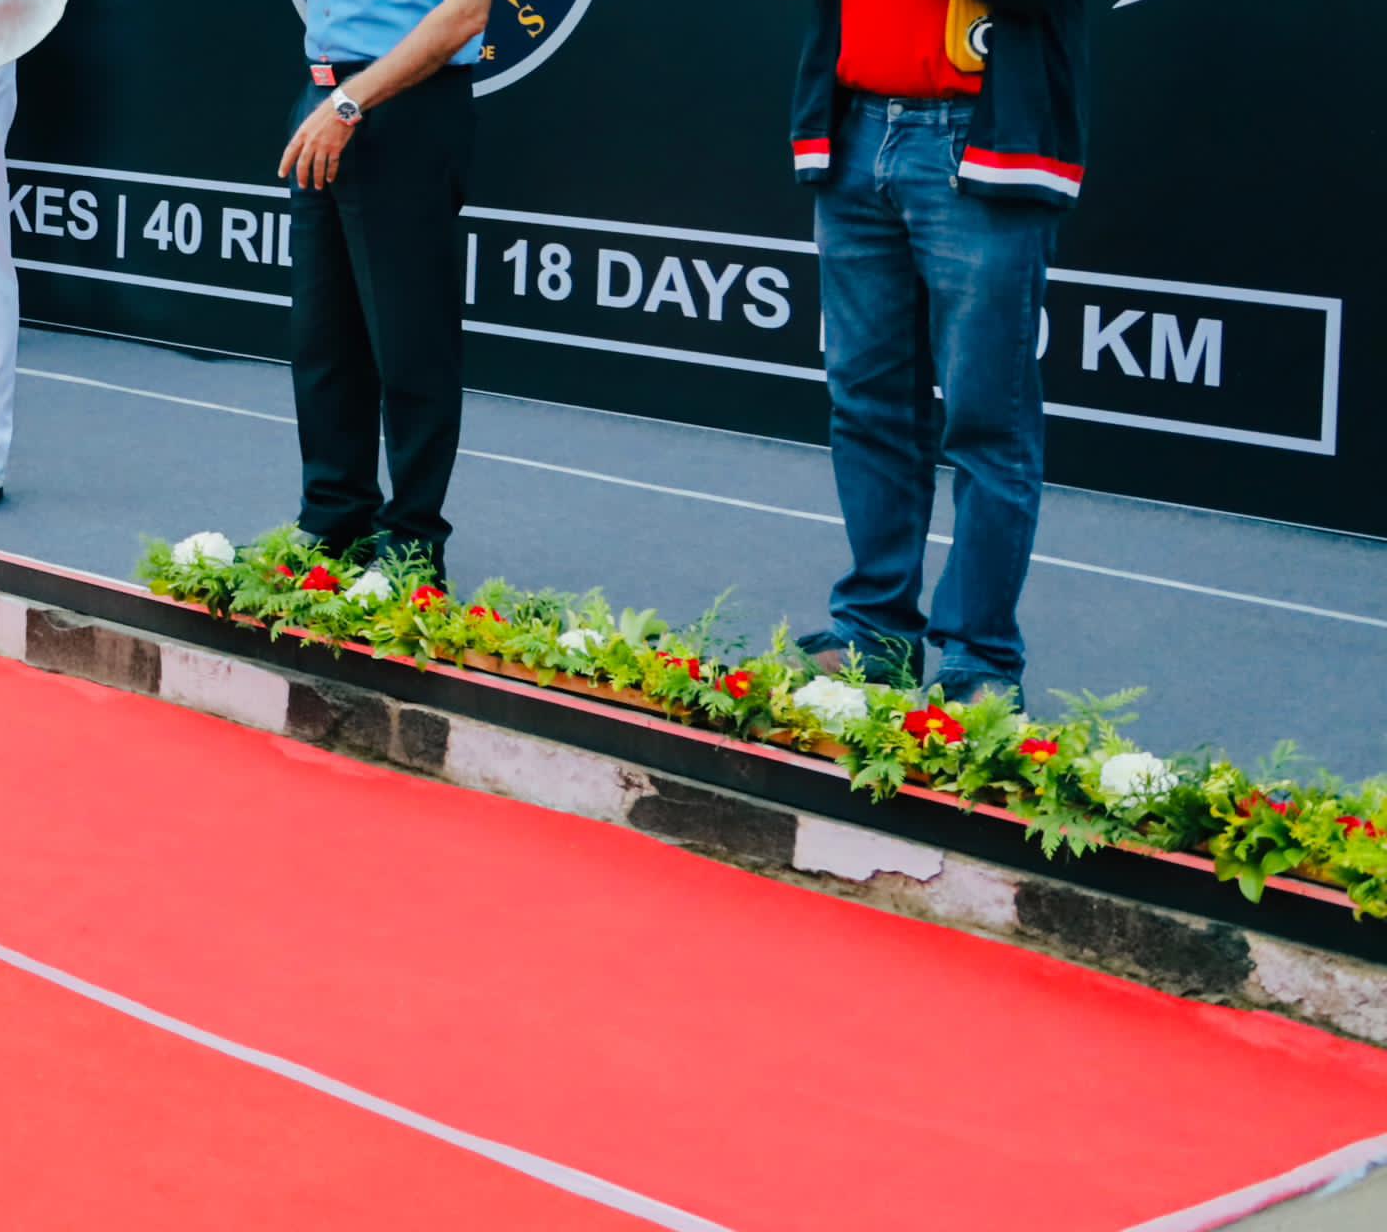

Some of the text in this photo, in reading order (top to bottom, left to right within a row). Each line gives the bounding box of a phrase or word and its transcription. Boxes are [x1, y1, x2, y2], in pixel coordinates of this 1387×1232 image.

[518, 5, 546, 38] S
[8, 185, 99, 241] KES
[143, 200, 203, 255] 40
[503, 239, 573, 301] 18
[596, 248, 791, 329] DAYS
[1082, 304, 1223, 387] KM
